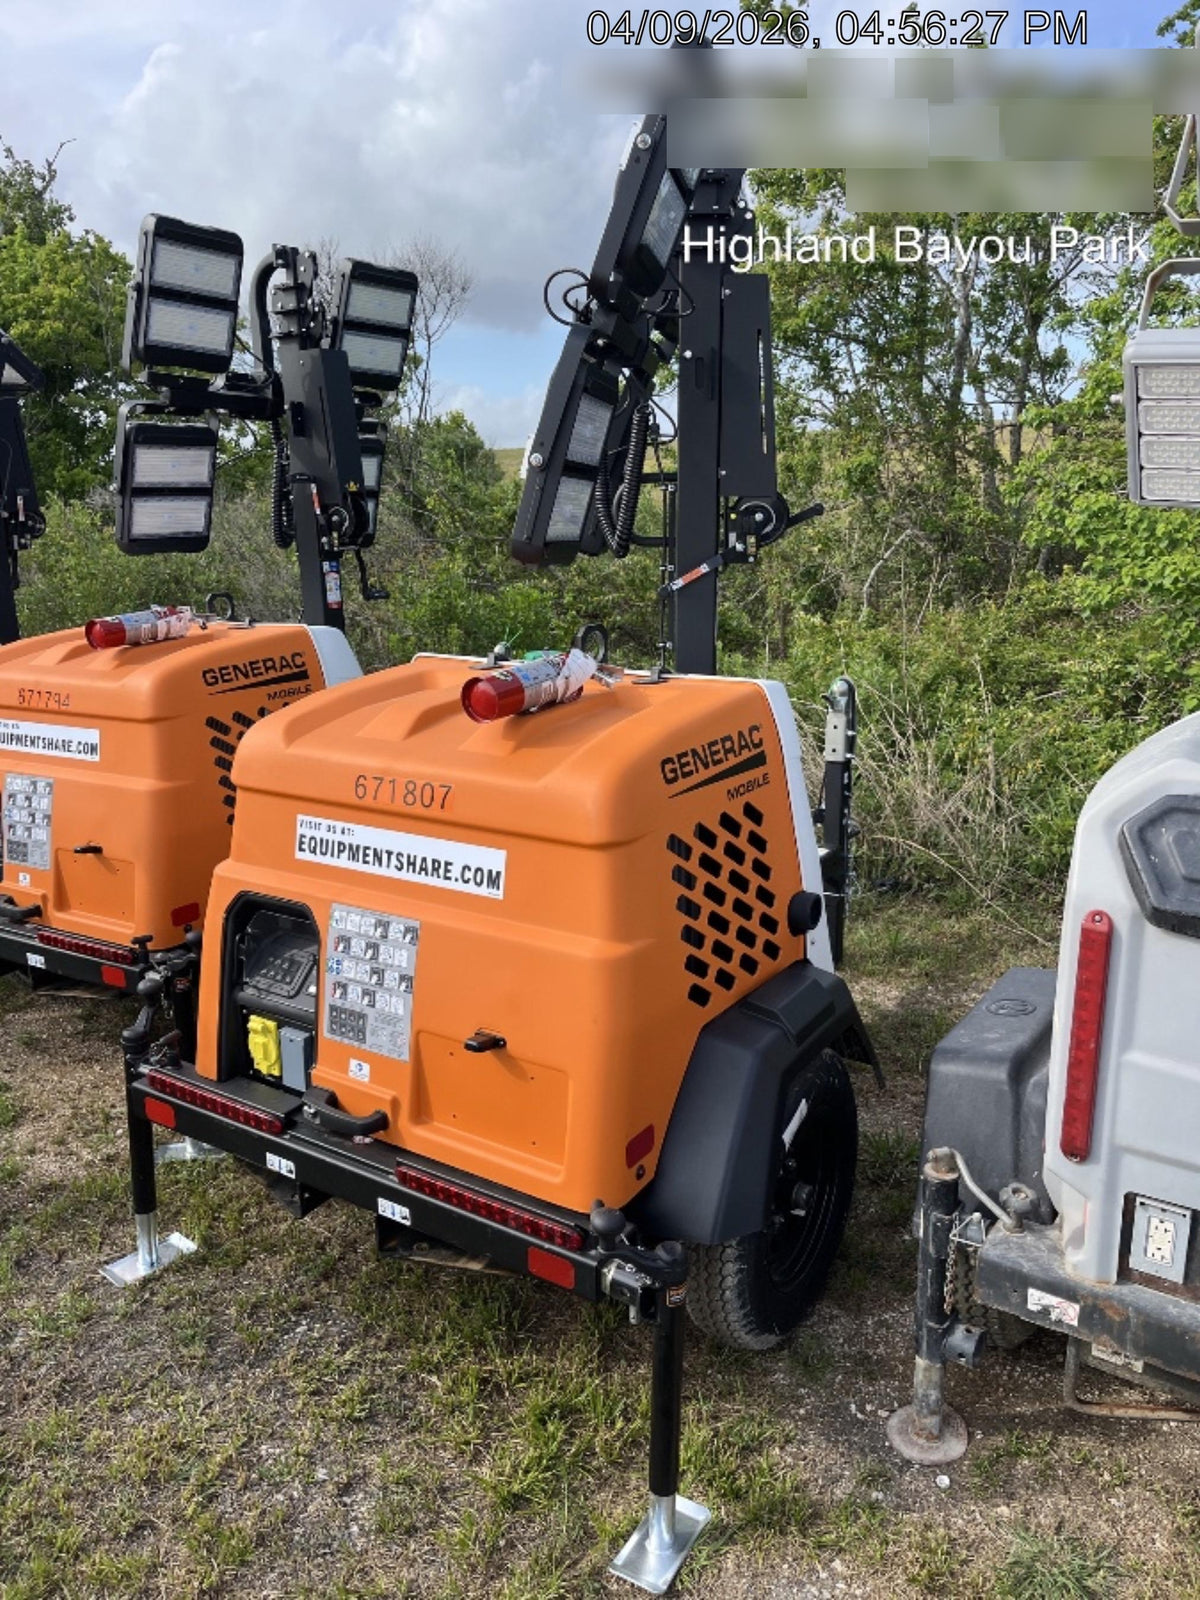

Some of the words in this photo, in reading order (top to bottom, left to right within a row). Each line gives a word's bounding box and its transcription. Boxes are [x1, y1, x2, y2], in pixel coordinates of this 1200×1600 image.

[202, 652, 306, 686] GENERAC
[18, 687, 70, 709] 671794
[267, 684, 312, 700] MOBILE
[661, 724, 763, 785] GENERAC
[354, 774, 452, 810] 671807
[726, 772, 770, 802] MOBILE
[298, 833, 502, 891] EQUIPMENTSHARE.COM
